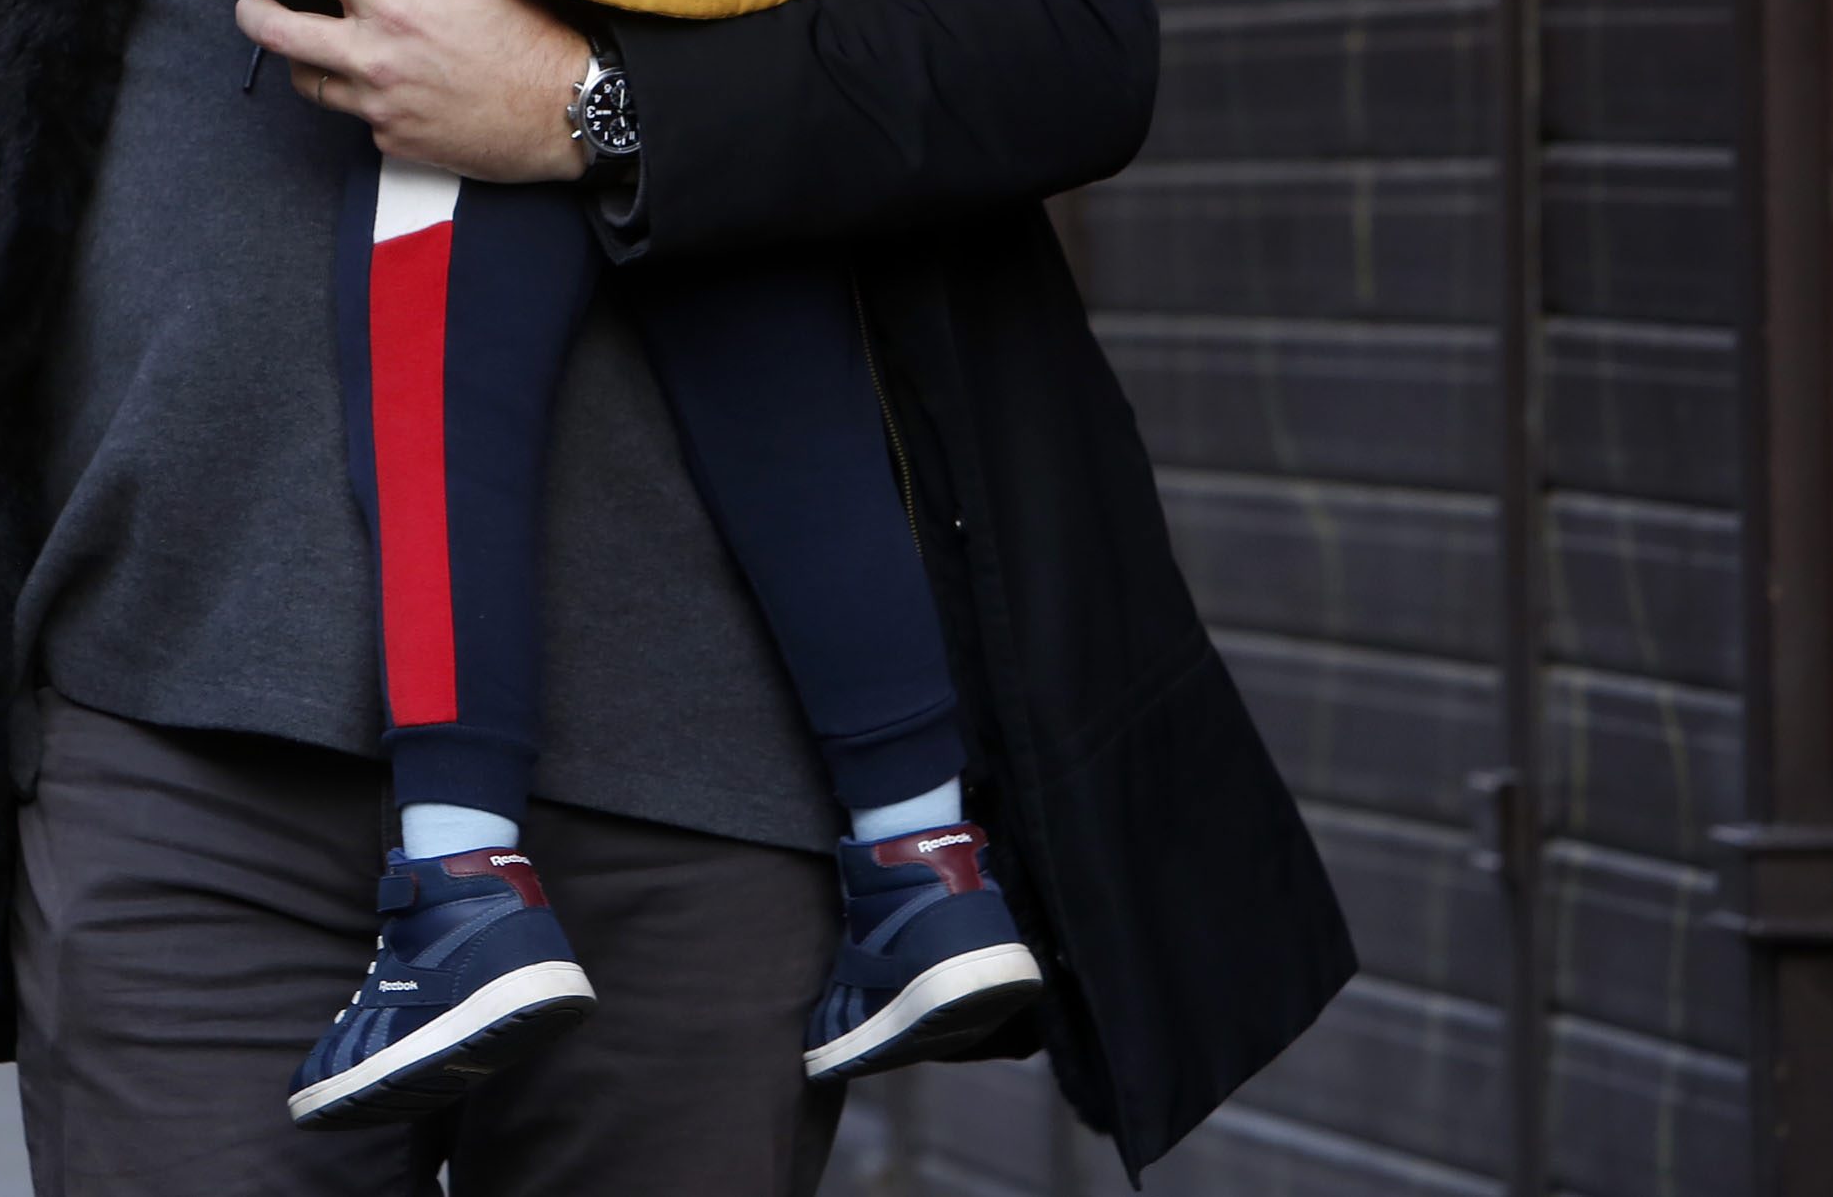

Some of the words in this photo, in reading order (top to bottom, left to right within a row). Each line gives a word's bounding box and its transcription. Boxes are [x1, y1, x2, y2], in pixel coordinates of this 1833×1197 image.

[594, 94, 602, 103] 4
[587, 105, 596, 119] 3
[593, 121, 601, 131] 2
[917, 832, 973, 853] Reebok
[489, 854, 532, 867] Reebo
[378, 981, 419, 992] Reebok
